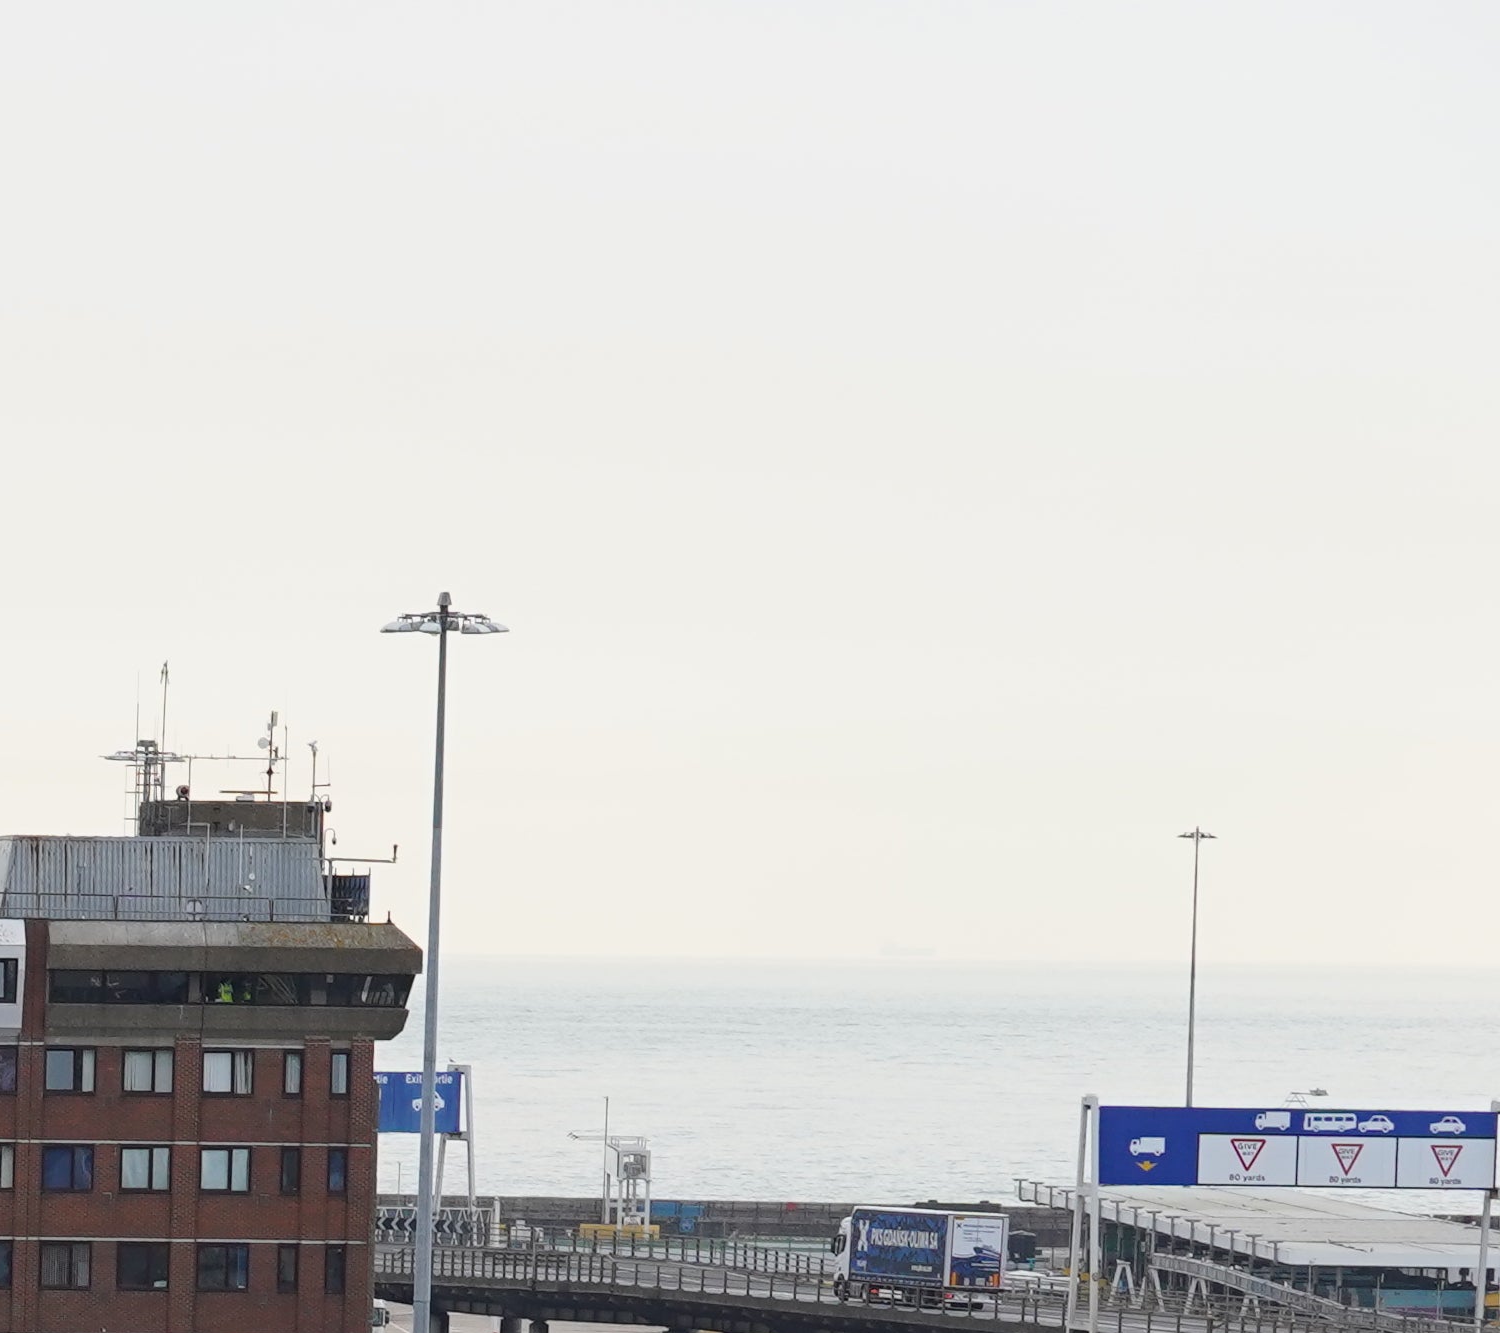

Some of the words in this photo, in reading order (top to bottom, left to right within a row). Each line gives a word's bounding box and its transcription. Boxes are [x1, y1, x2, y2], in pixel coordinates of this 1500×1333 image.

[1237, 1141, 1259, 1152] GIVE
[1229, 1173, 1241, 1182] 80
[1242, 1173, 1266, 1184] yards
[1329, 1175, 1341, 1184] 80
[1342, 1176, 1362, 1187] yards
[1430, 1177, 1441, 1186] 80
[1442, 1177, 1463, 1188] yards
